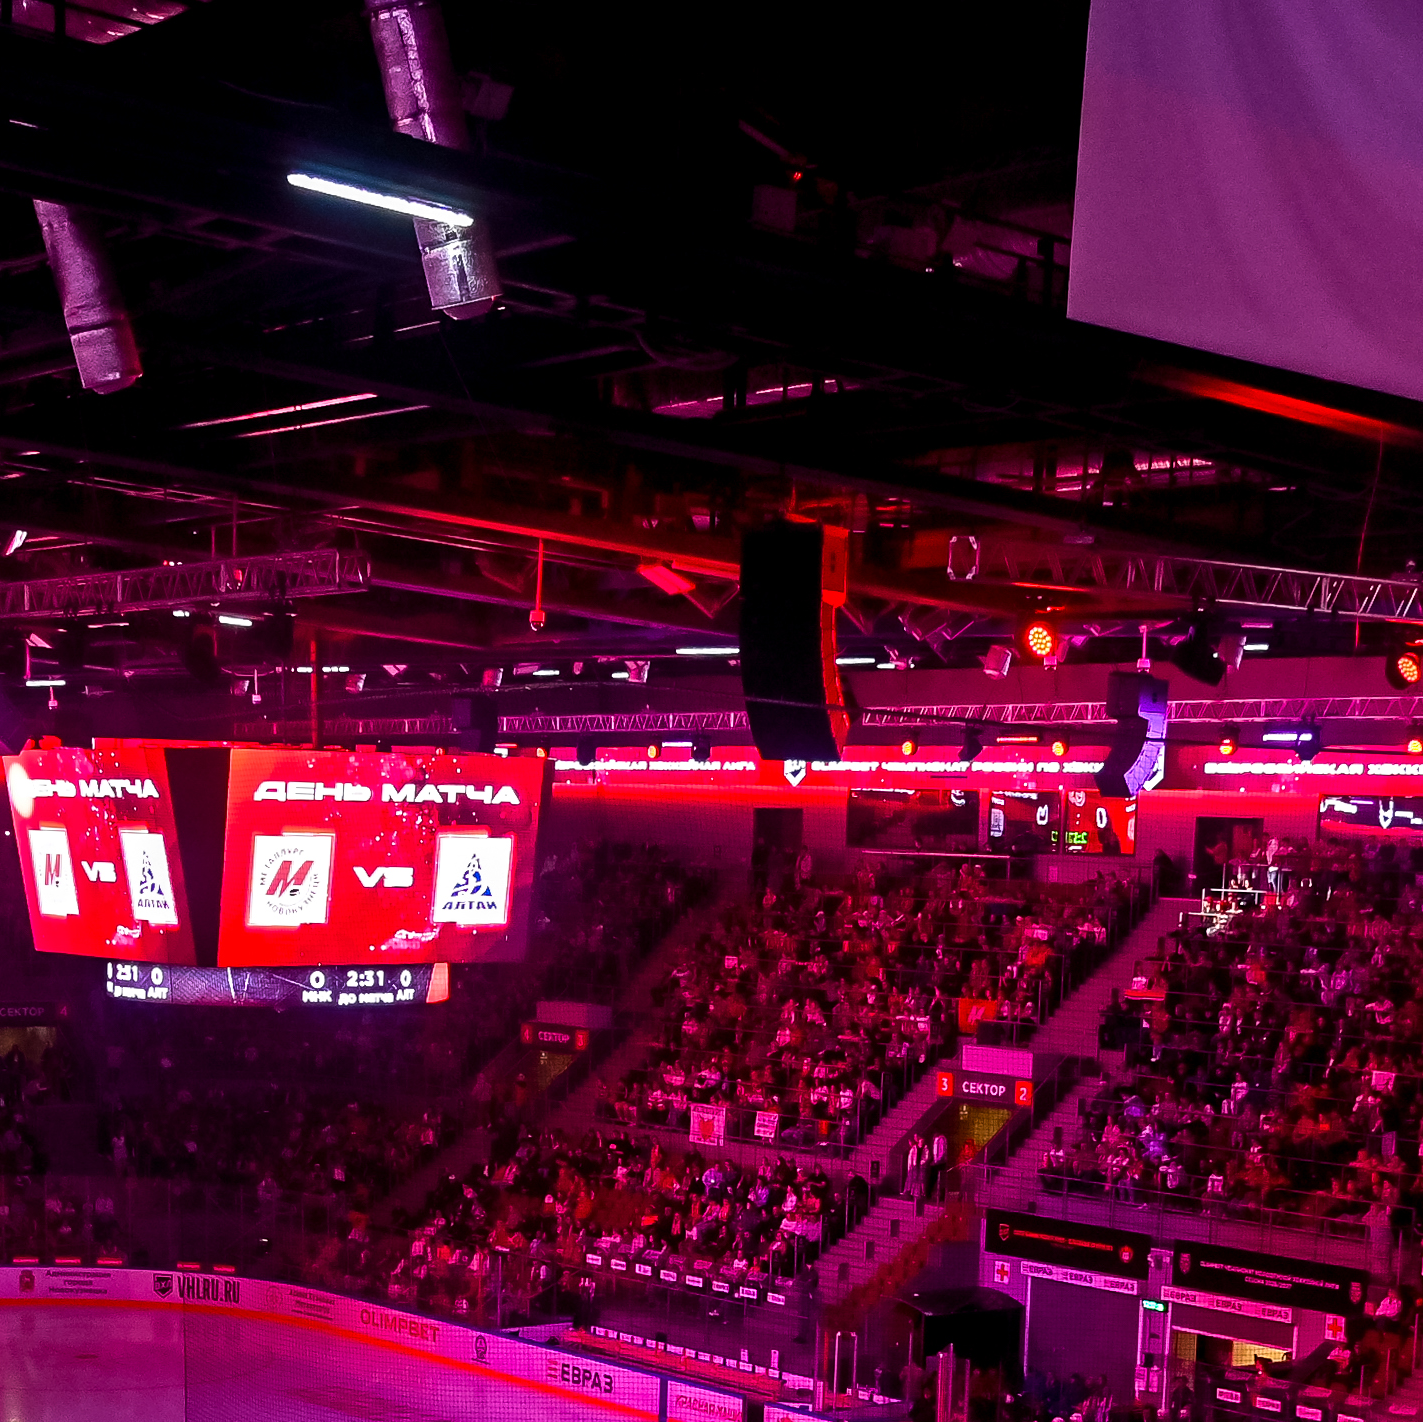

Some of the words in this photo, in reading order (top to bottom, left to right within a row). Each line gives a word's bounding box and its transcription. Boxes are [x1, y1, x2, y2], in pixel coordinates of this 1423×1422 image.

[253, 781, 371, 802] ДЕНЬ
[381, 783, 520, 805] МАТЧА
[80, 861, 117, 882] VS
[353, 866, 415, 888] VS
[346, 970, 385, 988] 2:31
[961, 1080, 1006, 1097] СЕКТОР
[360, 1308, 440, 1344] OLIMPBET
[560, 1361, 615, 1395] ЕВРАЗ
